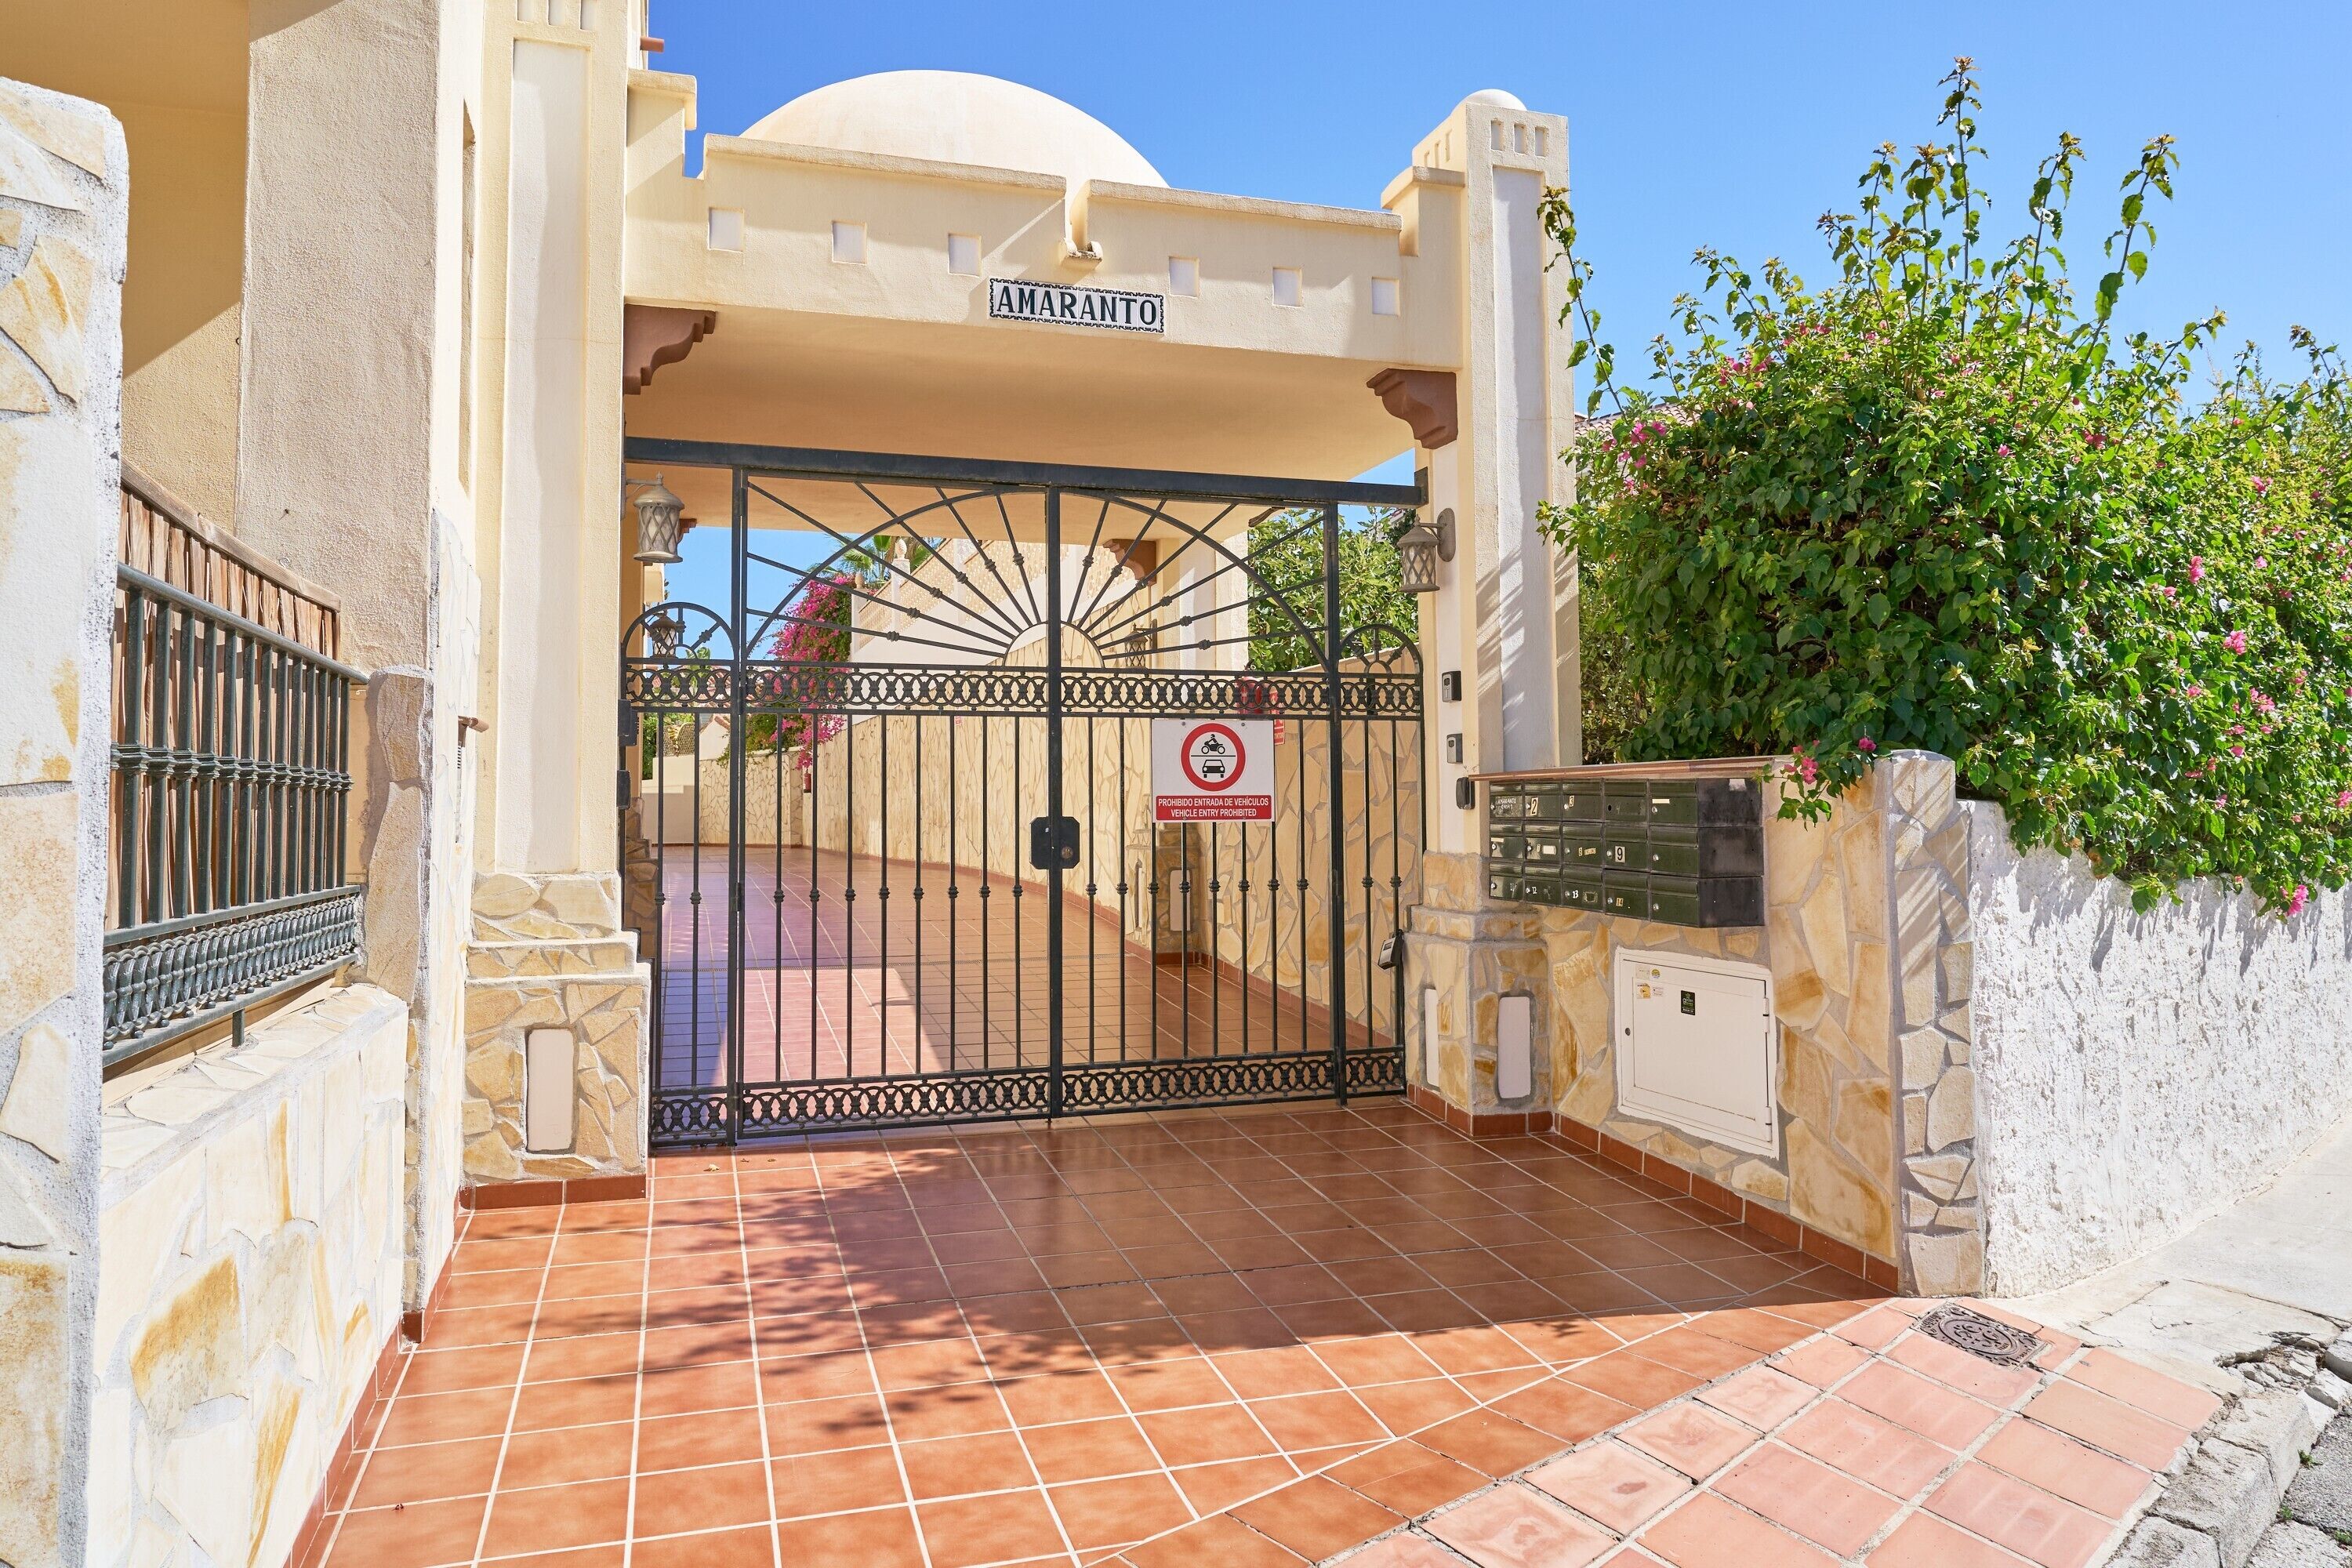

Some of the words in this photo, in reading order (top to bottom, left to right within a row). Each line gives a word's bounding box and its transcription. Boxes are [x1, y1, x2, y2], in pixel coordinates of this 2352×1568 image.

[996, 285, 1157, 325] AMARANTO
[1158, 798, 1193, 807] PROHIBIDO
[1234, 796, 1269, 806] VEHÍCULOS
[1532, 799, 1537, 815] 2
[1198, 808, 1219, 817] ENTRY
[1220, 808, 1257, 817] PROHIBITED
[1617, 847, 1623, 861] 9
[1572, 890, 1579, 899] 13
